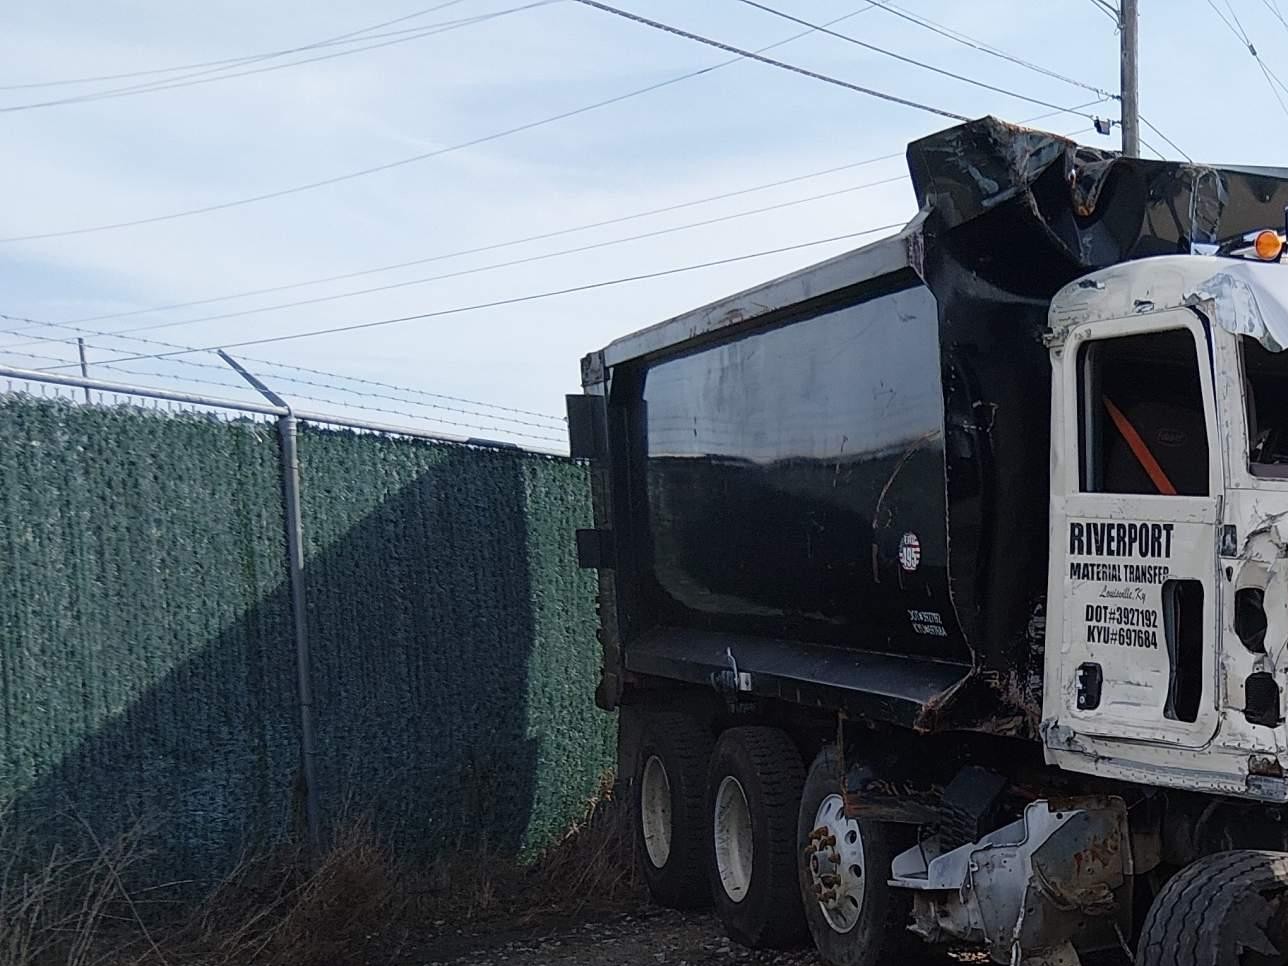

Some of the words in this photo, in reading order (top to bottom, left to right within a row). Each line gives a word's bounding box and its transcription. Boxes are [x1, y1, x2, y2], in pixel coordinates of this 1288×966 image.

[1069, 522, 1174, 558] RIVERPORT
[1069, 562, 1122, 582] MATERIAL
[1085, 604, 1158, 628] DOT#3927192
[1087, 625, 1158, 650] KYU#697684
